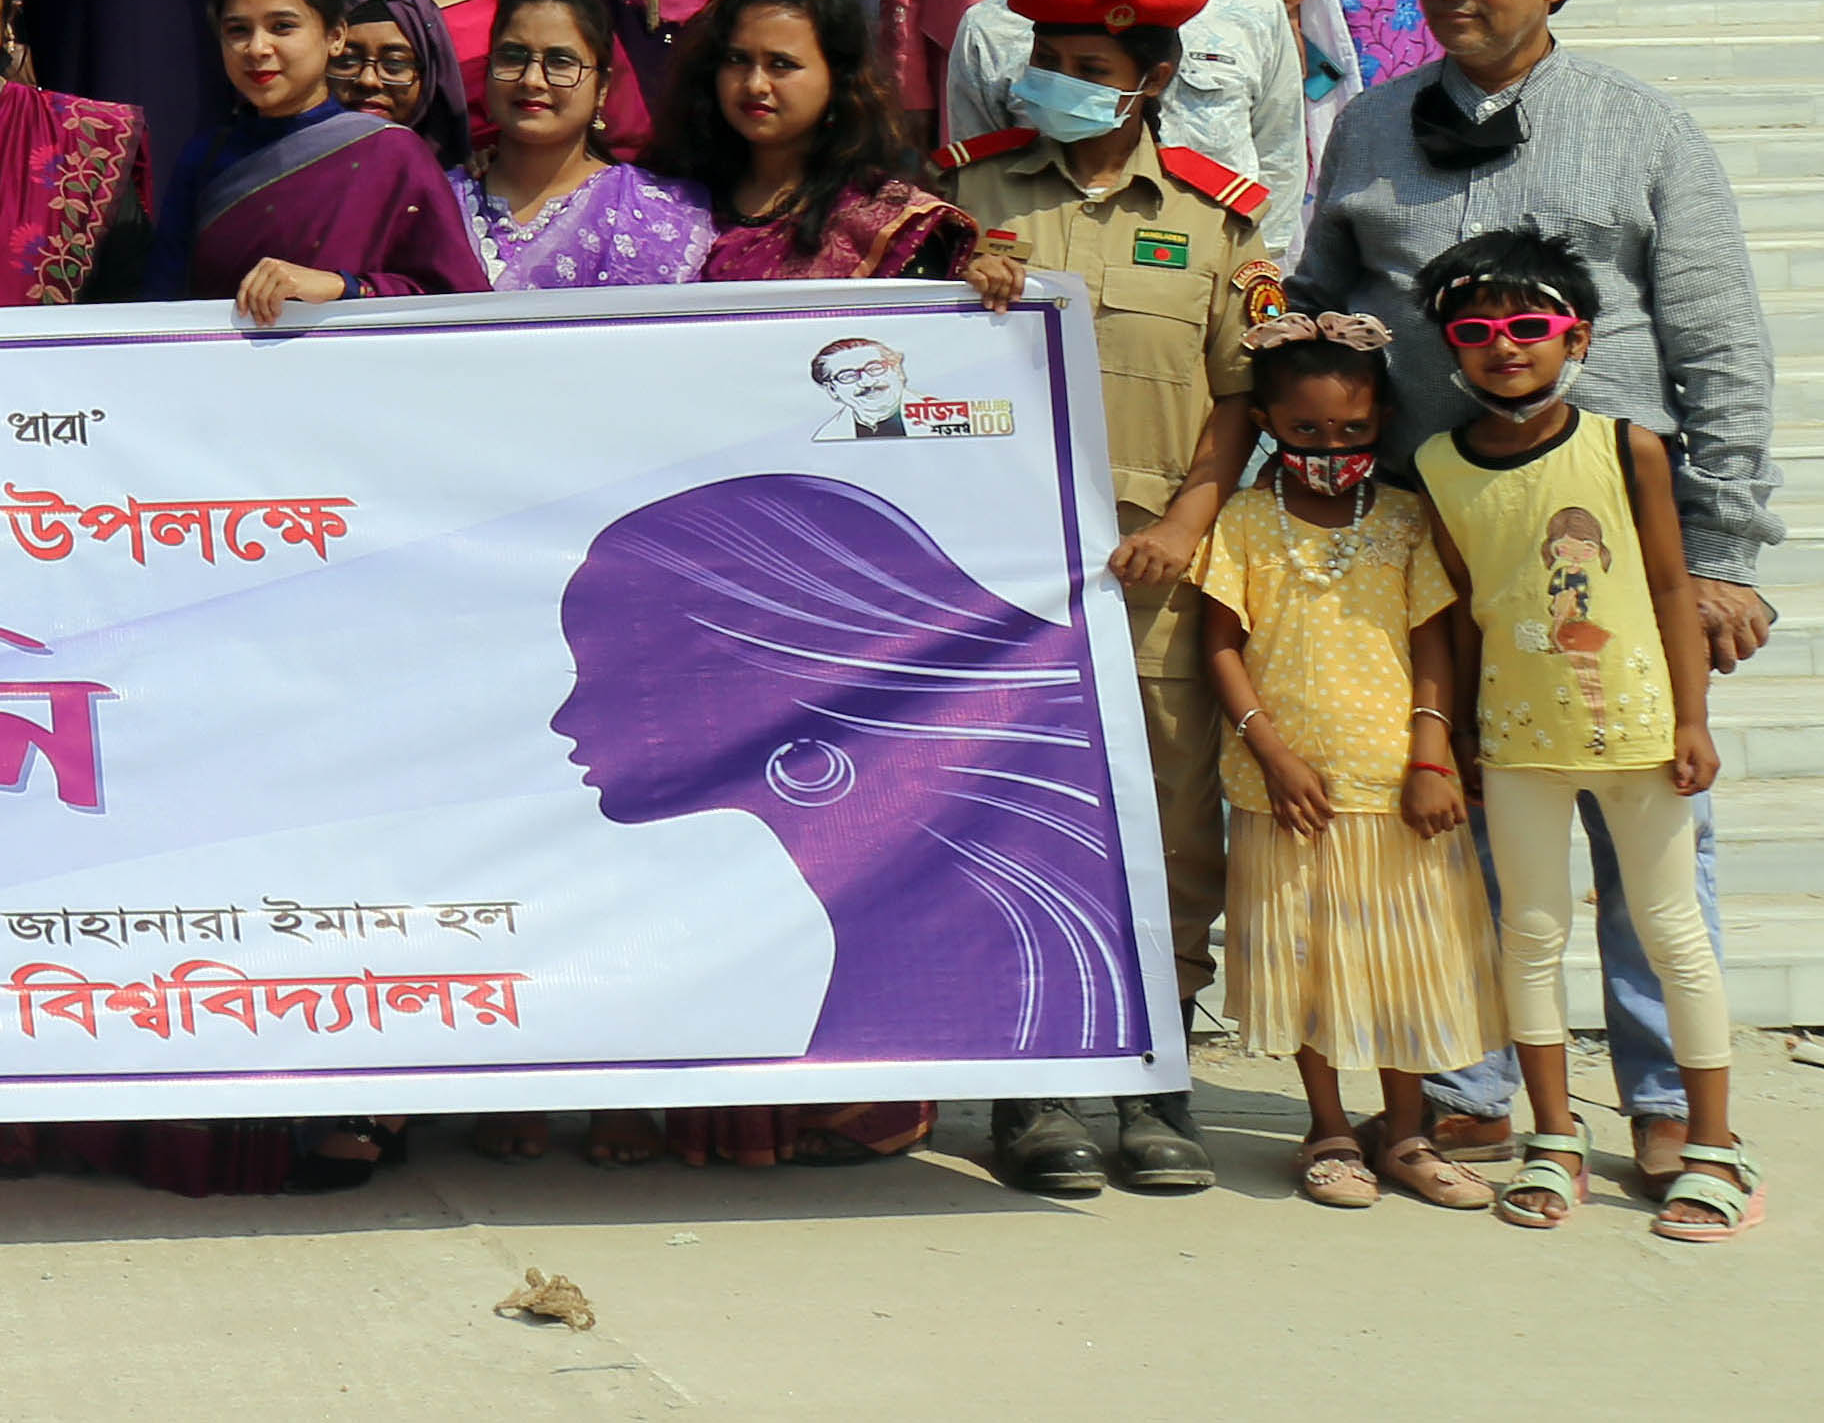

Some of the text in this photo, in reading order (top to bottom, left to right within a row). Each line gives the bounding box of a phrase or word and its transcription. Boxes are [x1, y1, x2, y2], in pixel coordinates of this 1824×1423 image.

[0, 482, 355, 569] উপলক্ষে
[3, 906, 243, 946] জাহানারা
[261, 897, 416, 946] ইমাম
[435, 899, 520, 939] হল
[6, 957, 532, 1045] বিশ্ববিদ্যালয়
